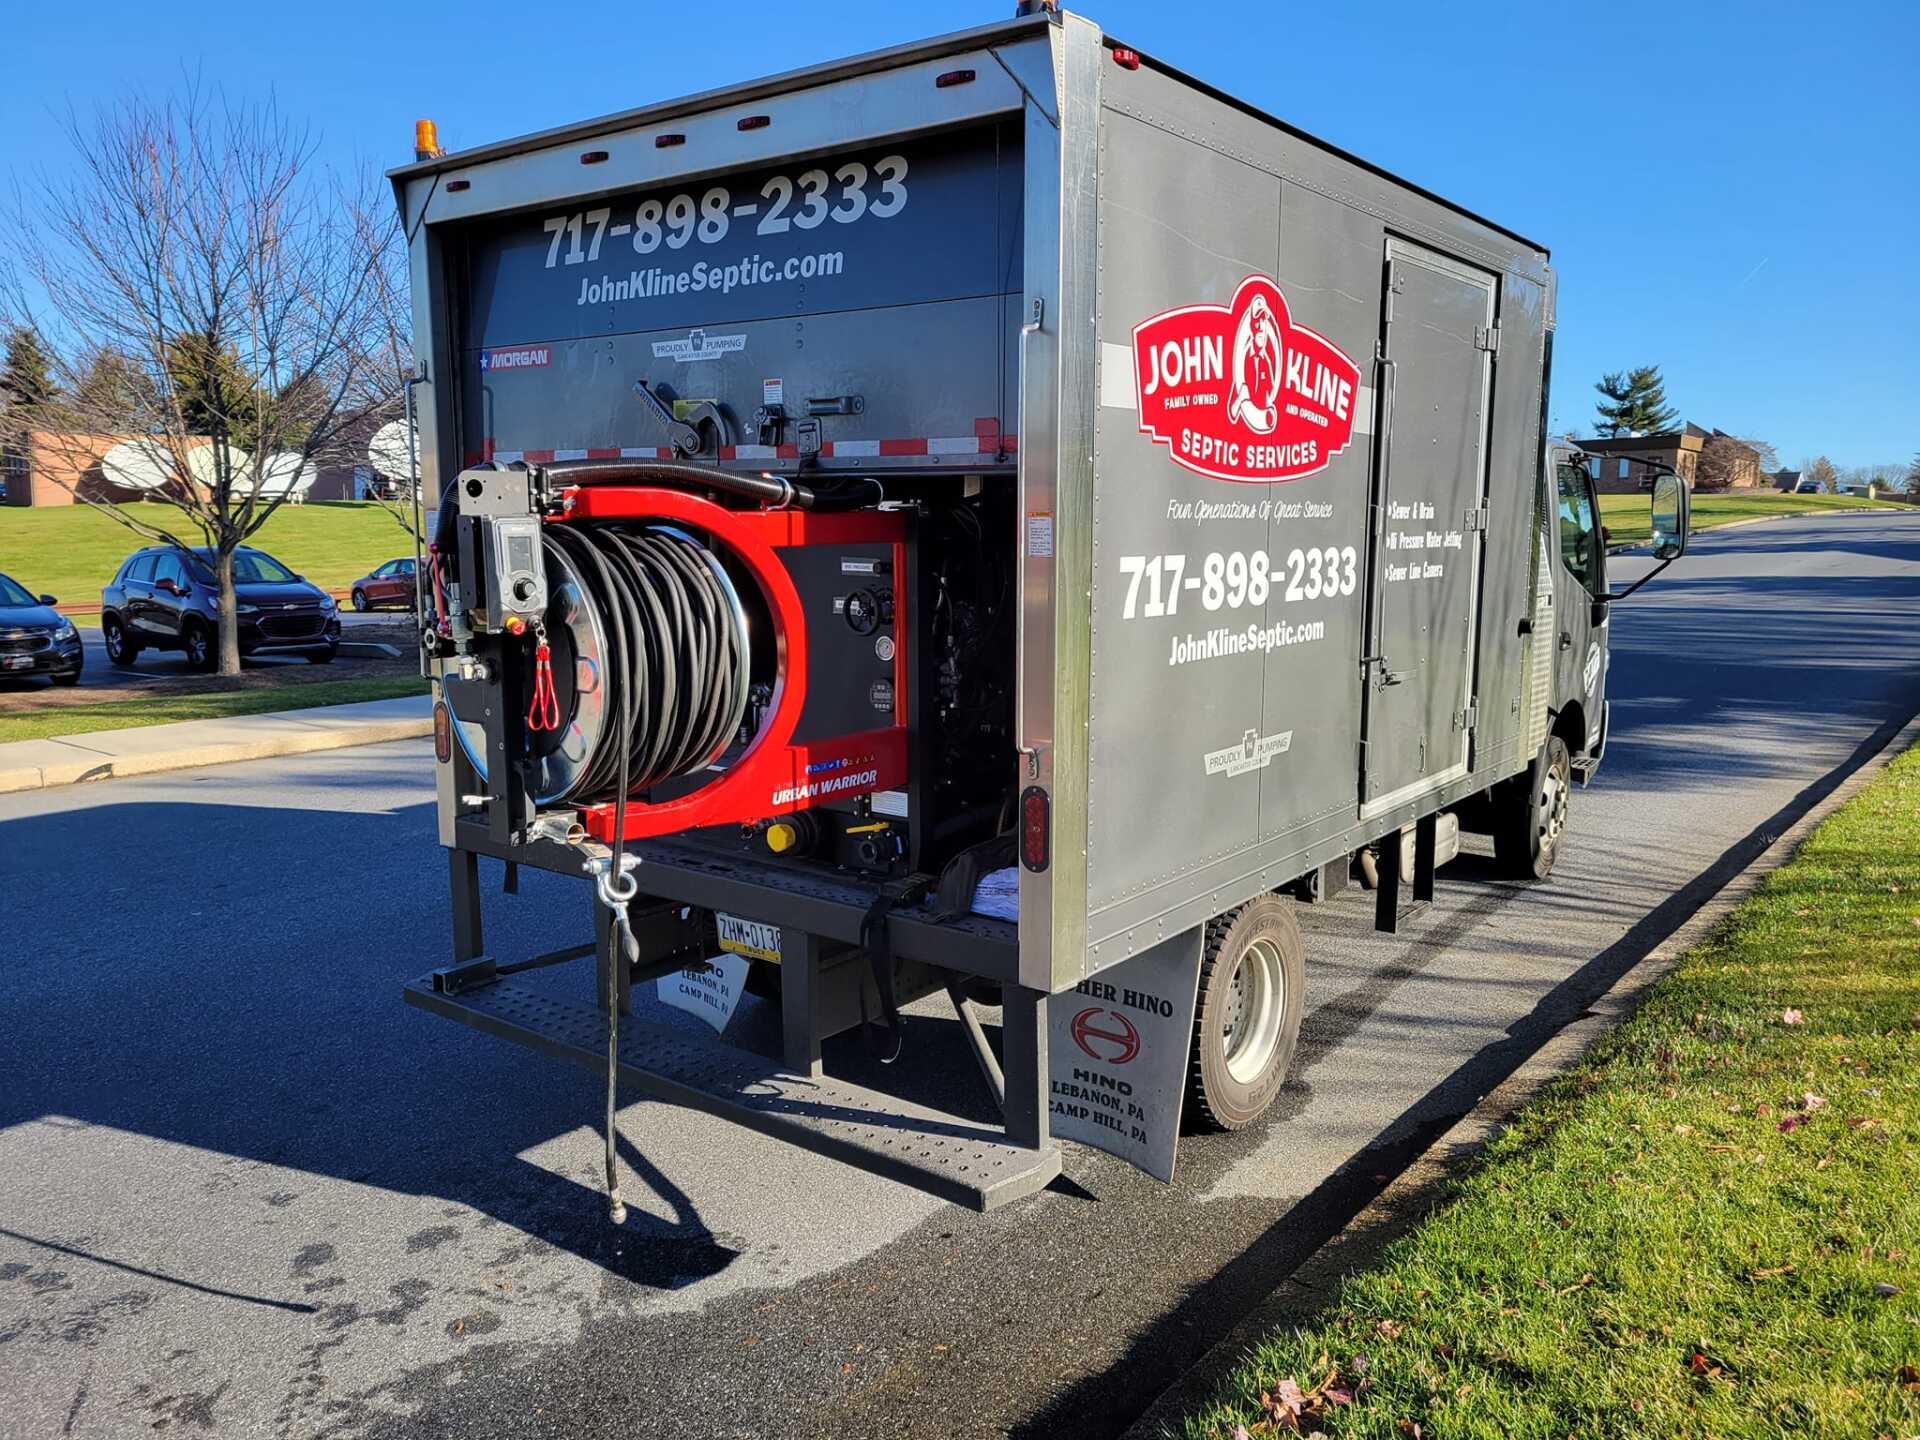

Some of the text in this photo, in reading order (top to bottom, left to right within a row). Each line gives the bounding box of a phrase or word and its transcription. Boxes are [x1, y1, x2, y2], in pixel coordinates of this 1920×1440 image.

[543, 155, 909, 268] 717-898-2333
[577, 251, 844, 306] JohnKlineSeptic.com
[491, 350, 549, 369] MORGAN
[656, 343, 689, 353] PROUDLY
[706, 338, 742, 349] PUMPING
[1144, 335, 1352, 421] JOHN KLINE
[1164, 393, 1218, 410] FAMILY OWNED
[1286, 404, 1328, 427] AND OPERATED
[1181, 428, 1317, 469] SEPTIC SERVICES
[1166, 499, 1334, 526] Four Generations Of Great Service
[1391, 501, 1411, 520] Sewer
[1399, 531, 1424, 549] Pressure
[1119, 546, 1357, 620] 717-898-2333
[1169, 620, 1324, 666] JohnKlineSeptic.com
[1210, 751, 1240, 767] PROUDLY
[1258, 736, 1288, 754] PUMPING
[772, 783, 818, 806] URBAN
[821, 769, 878, 794] WARRIOR
[679, 984, 702, 1000] CAMP
[1123, 989, 1173, 1018] HINO
[1073, 1068, 1133, 1096] HINO
[1052, 1081, 1145, 1121] LEBANON, PA
[1093, 1111, 1128, 1136] HILL,
[1132, 1126, 1147, 1144] PA
